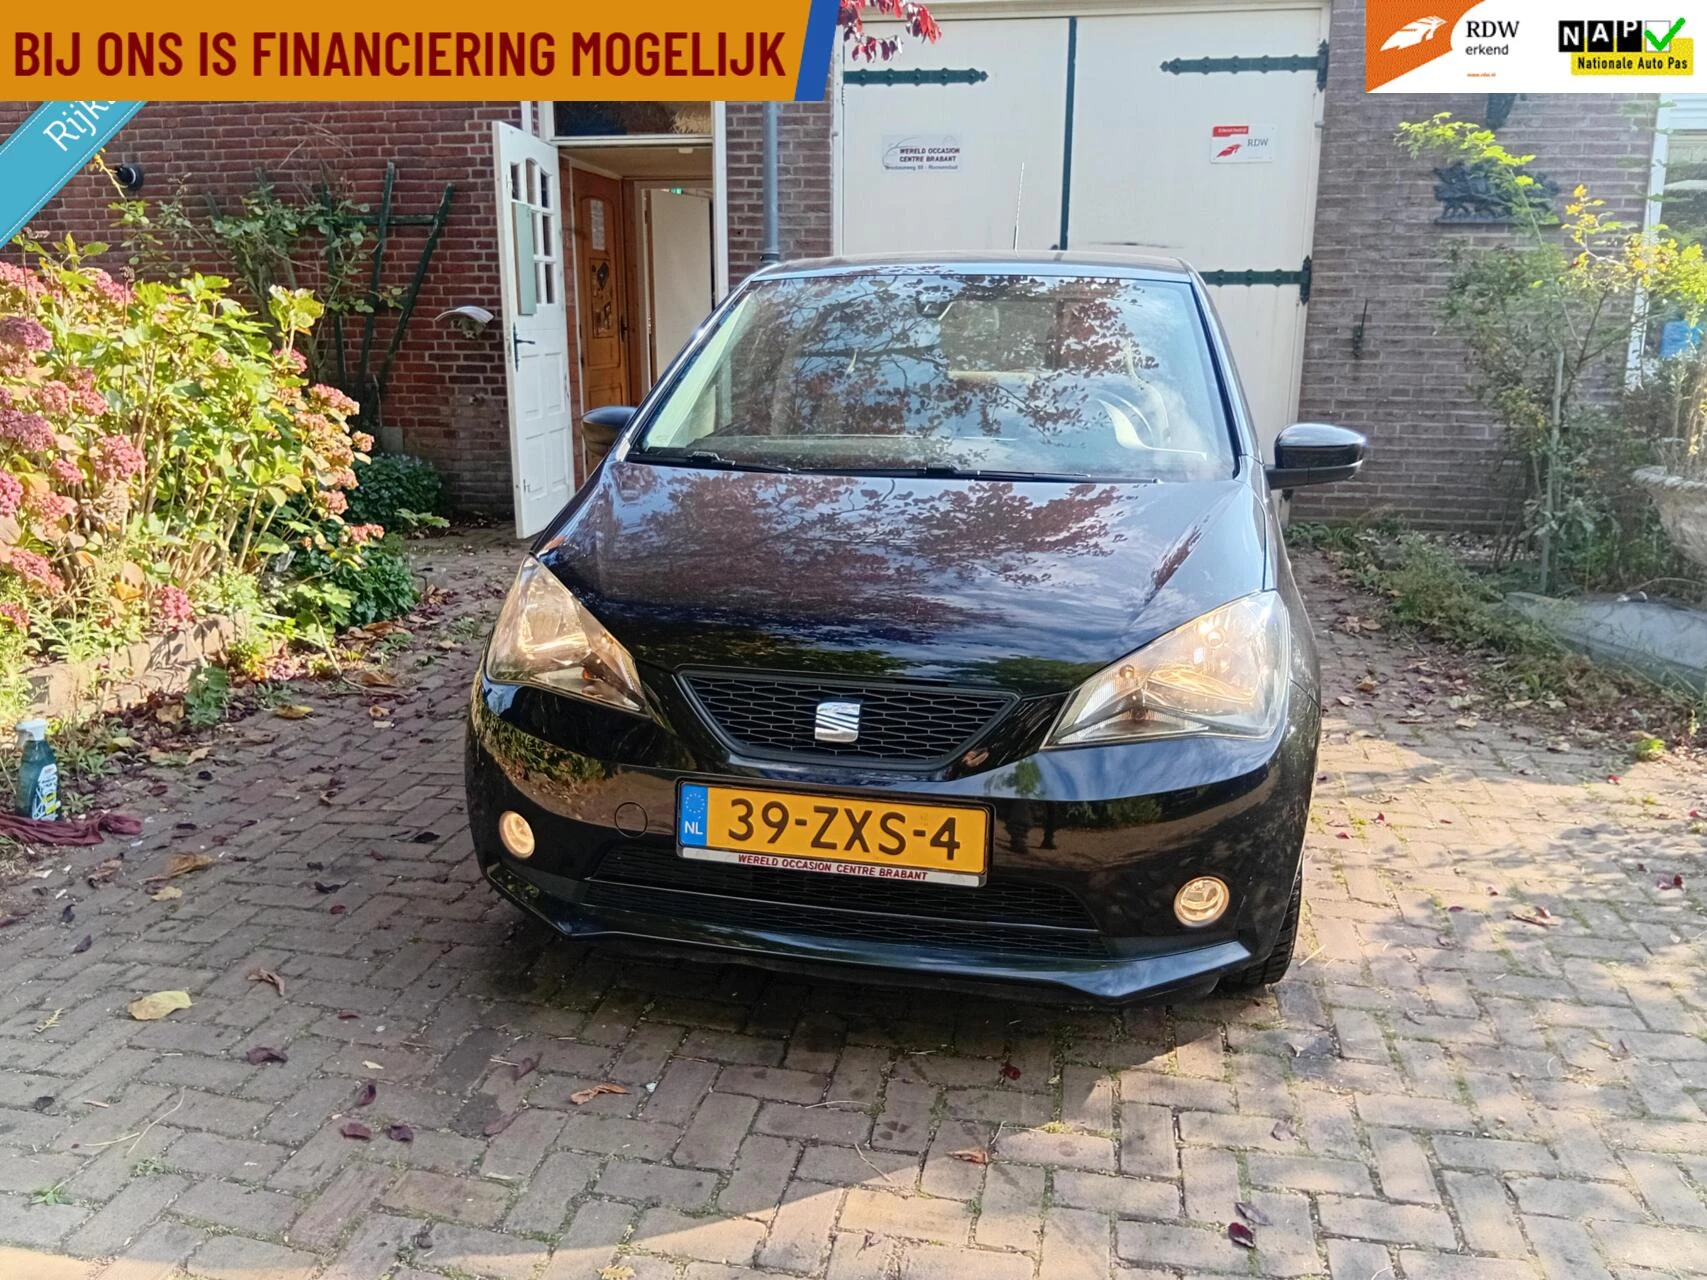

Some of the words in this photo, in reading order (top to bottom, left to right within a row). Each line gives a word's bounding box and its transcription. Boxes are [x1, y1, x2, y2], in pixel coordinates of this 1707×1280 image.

[1247, 138, 1268, 147] RDW
[684, 821, 704, 835] NL
[728, 798, 960, 860] 39-ZXS-4
[738, 854, 778, 866] WERELD
[782, 859, 831, 872] OCCASION
[836, 864, 876, 876] CENTRE
[879, 869, 928, 880] BRABANT
